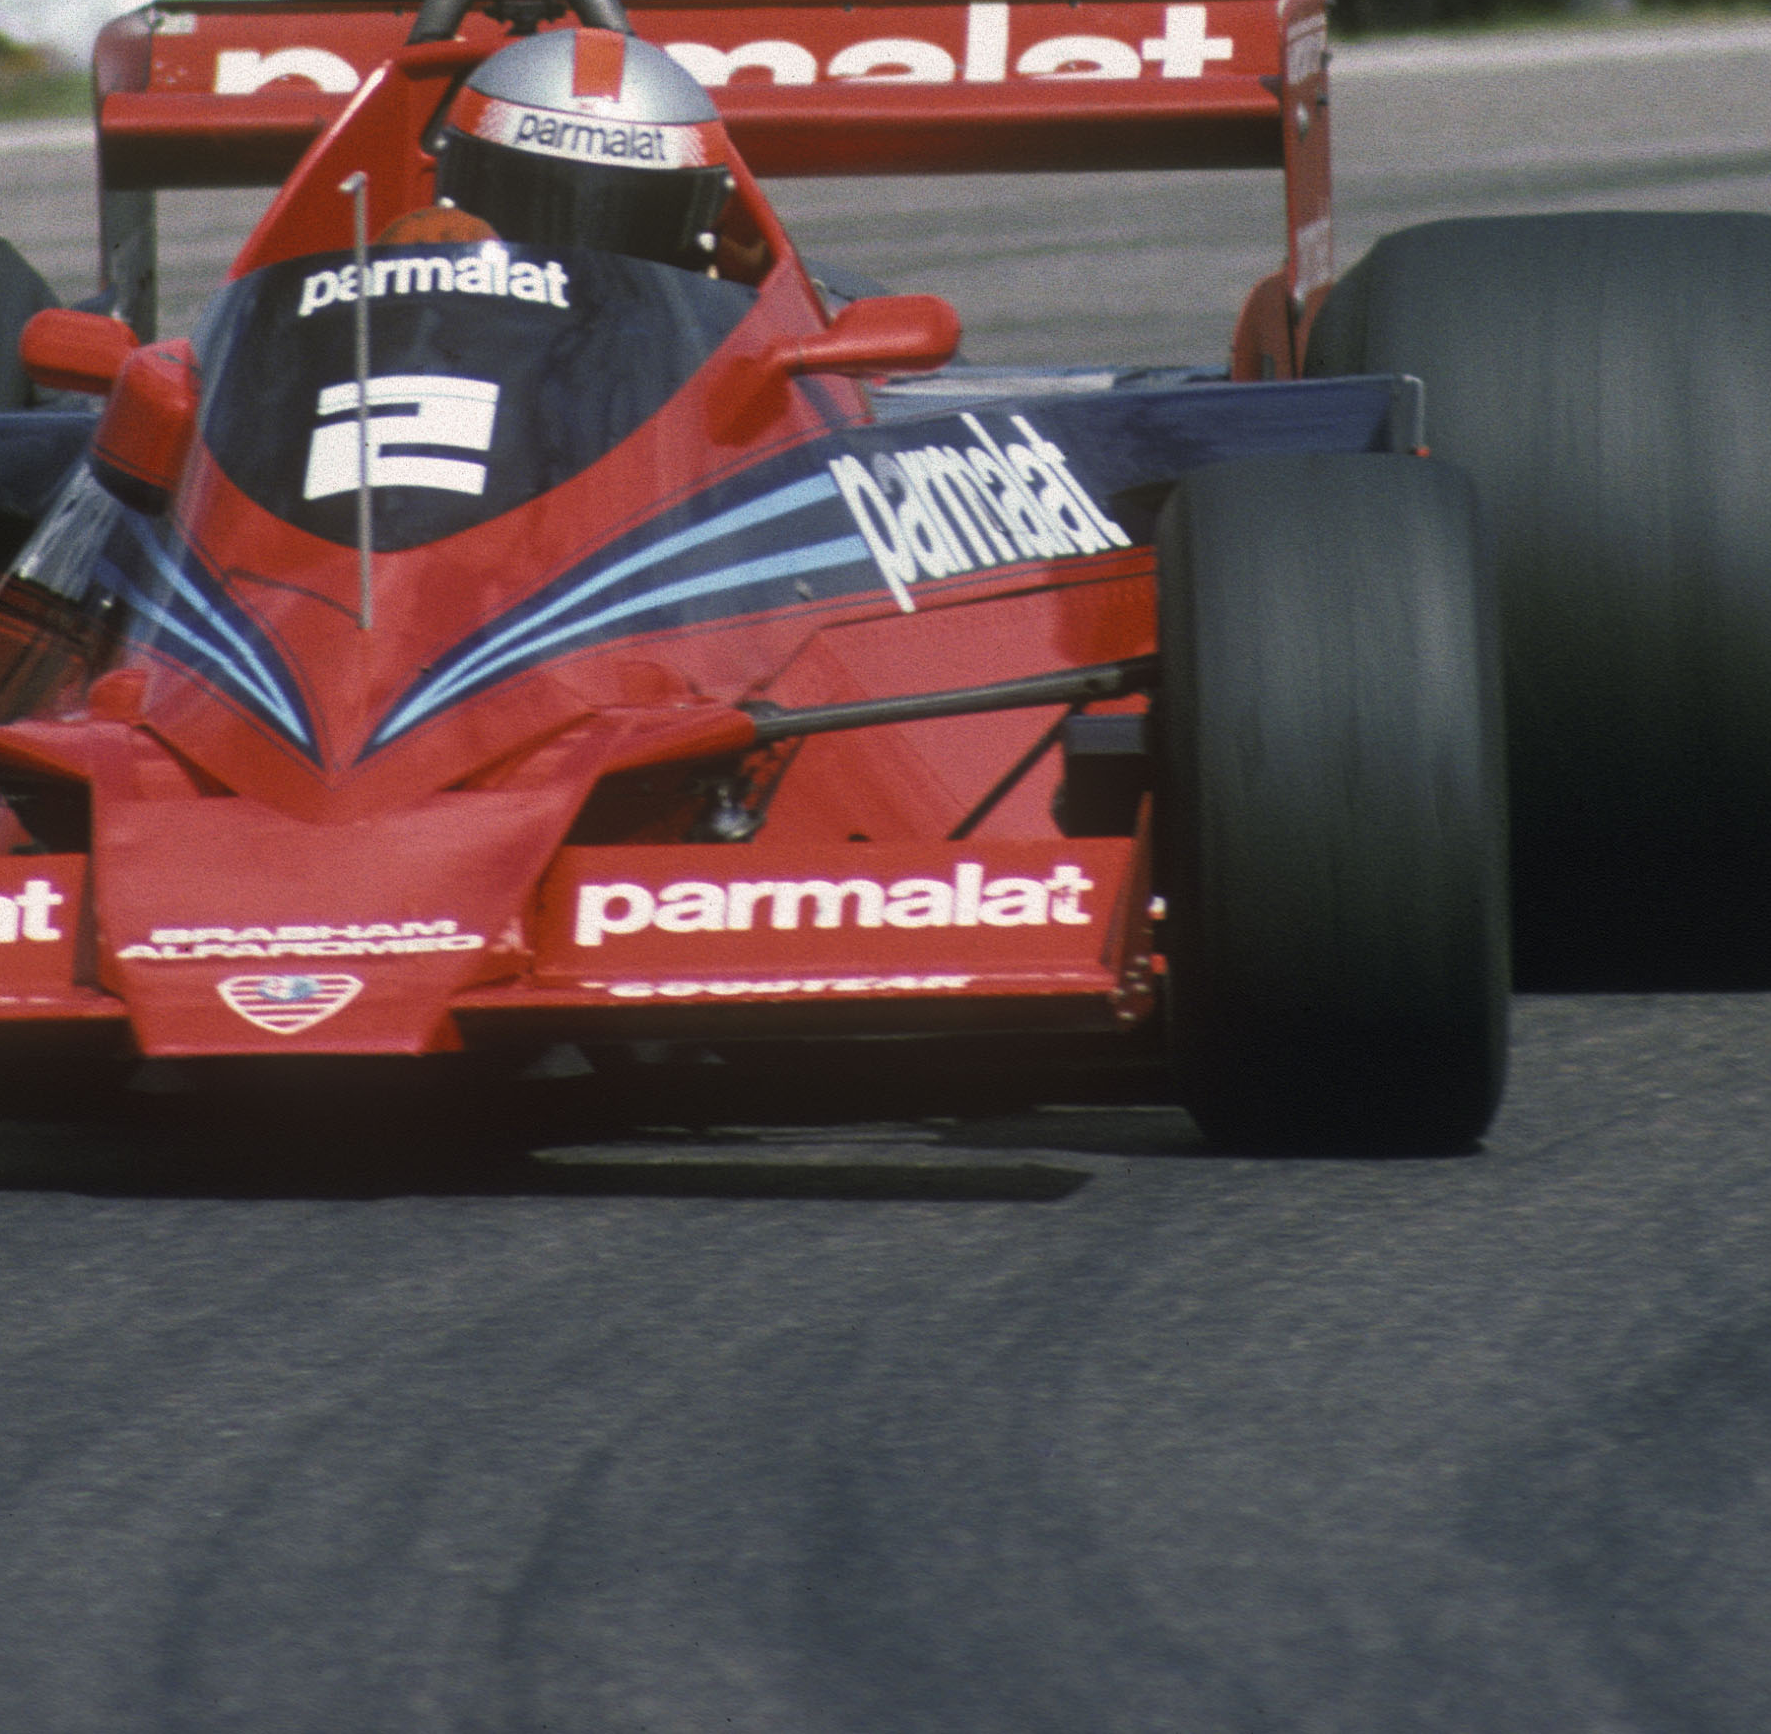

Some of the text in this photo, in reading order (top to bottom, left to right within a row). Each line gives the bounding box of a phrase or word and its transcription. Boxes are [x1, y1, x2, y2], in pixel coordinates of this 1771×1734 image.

[216, 1, 1233, 95] pmalat
[513, 113, 666, 161] parmalat
[297, 240, 570, 316] parmalat
[303, 375, 500, 501] 2
[829, 412, 1133, 613] parmalat
[150, 920, 458, 944] BRABHAM
[574, 862, 1093, 947] parmalat
